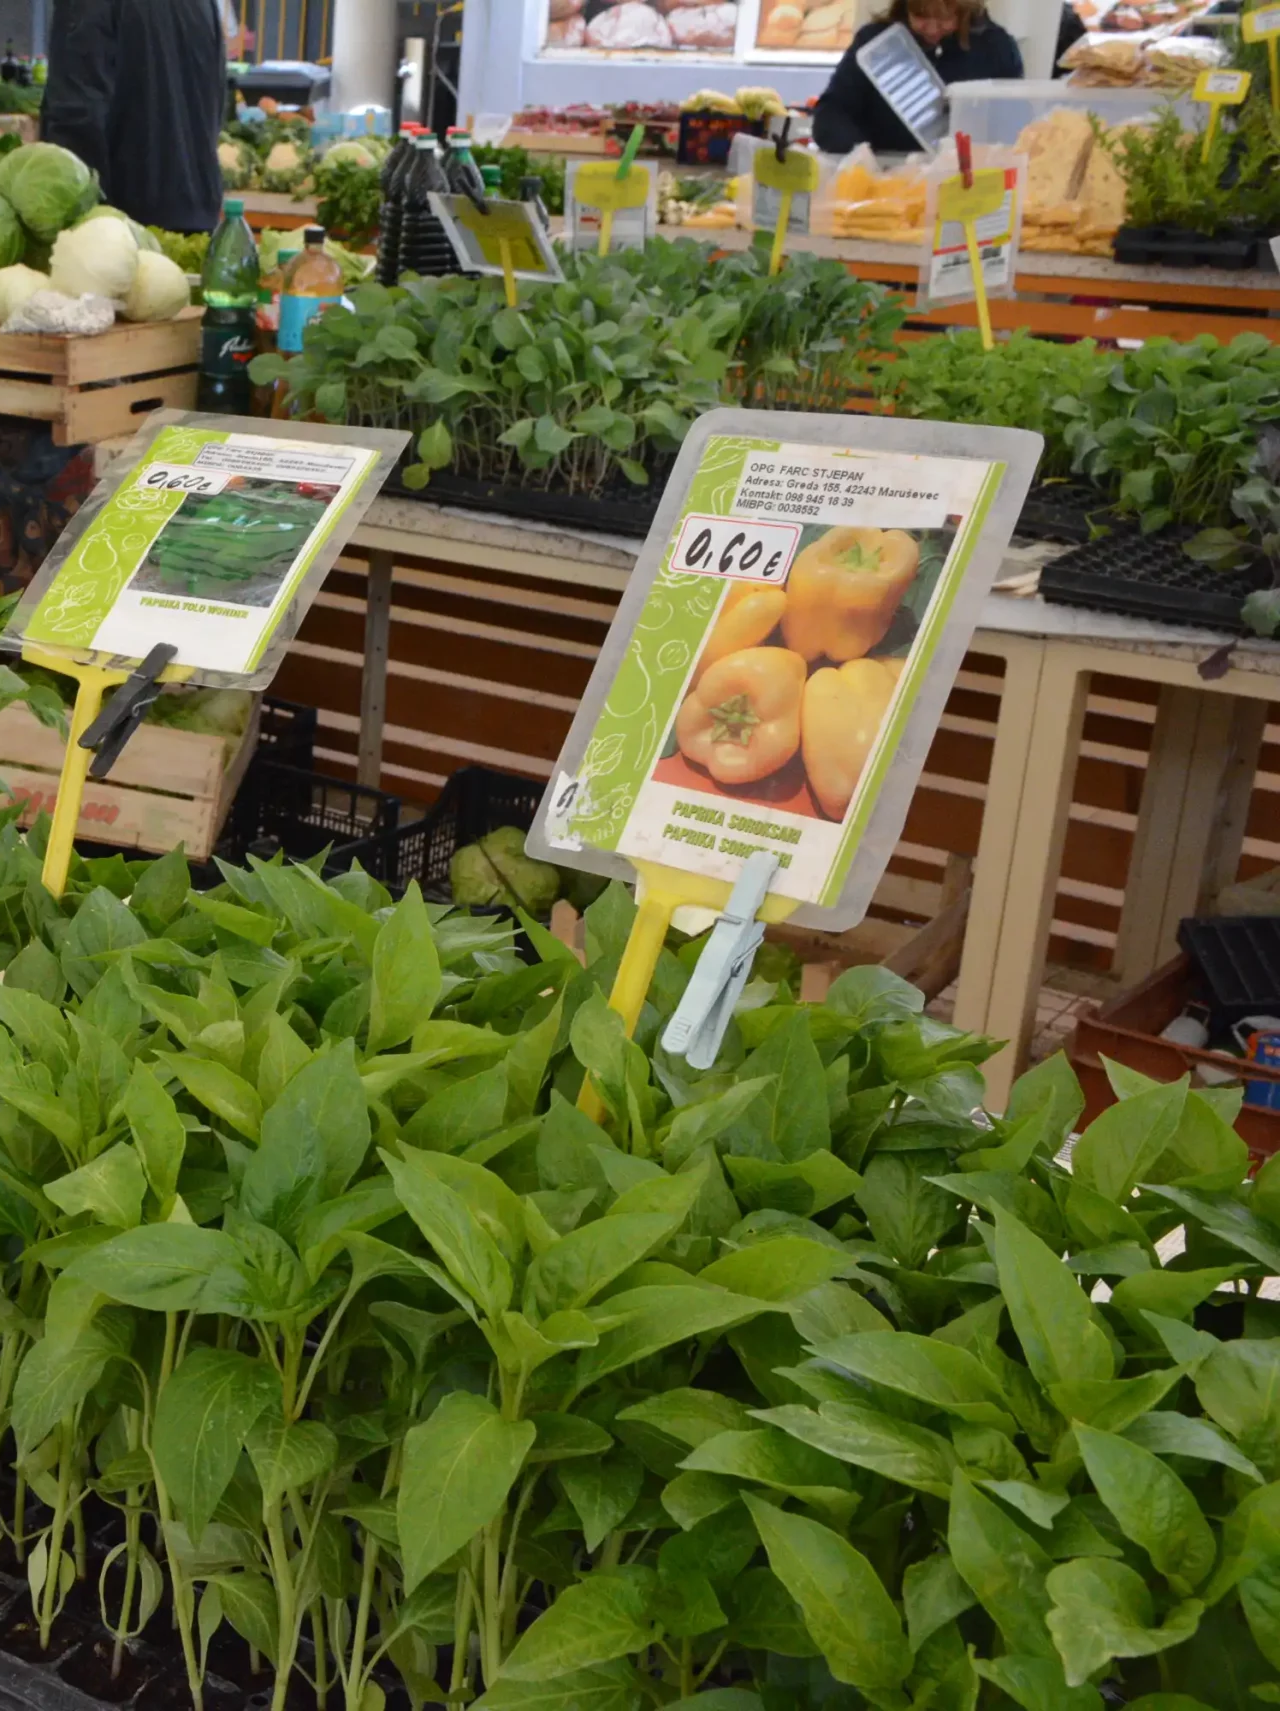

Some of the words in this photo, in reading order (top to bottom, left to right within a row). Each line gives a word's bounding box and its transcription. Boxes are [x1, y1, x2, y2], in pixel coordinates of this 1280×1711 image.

[750, 462, 775, 474] OPG
[779, 465, 810, 477] FARC
[812, 467, 865, 482] STJEPAN
[740, 487, 783, 501] Kontakt:
[785, 492, 803, 503] 098
[805, 494, 824, 504] 945
[827, 496, 840, 506] 18
[841, 498, 854, 507] 39
[745, 475, 784, 488] Adresa:
[786, 480, 819, 491] Greda
[845, 485, 876, 497] 42243
[878, 487, 939, 501] Maruševec
[736, 498, 776, 512] MIBPG:
[777, 503, 820, 517] 0038552
[140, 596, 181, 612] PAPRIKA
[182, 600, 207, 614] YOLO
[208, 604, 249, 619] WONDER
[671, 800, 725, 827] PAPRIKA
[727, 813, 802, 845] SOROKSARI
[662, 823, 716, 850] PAPRIKA
